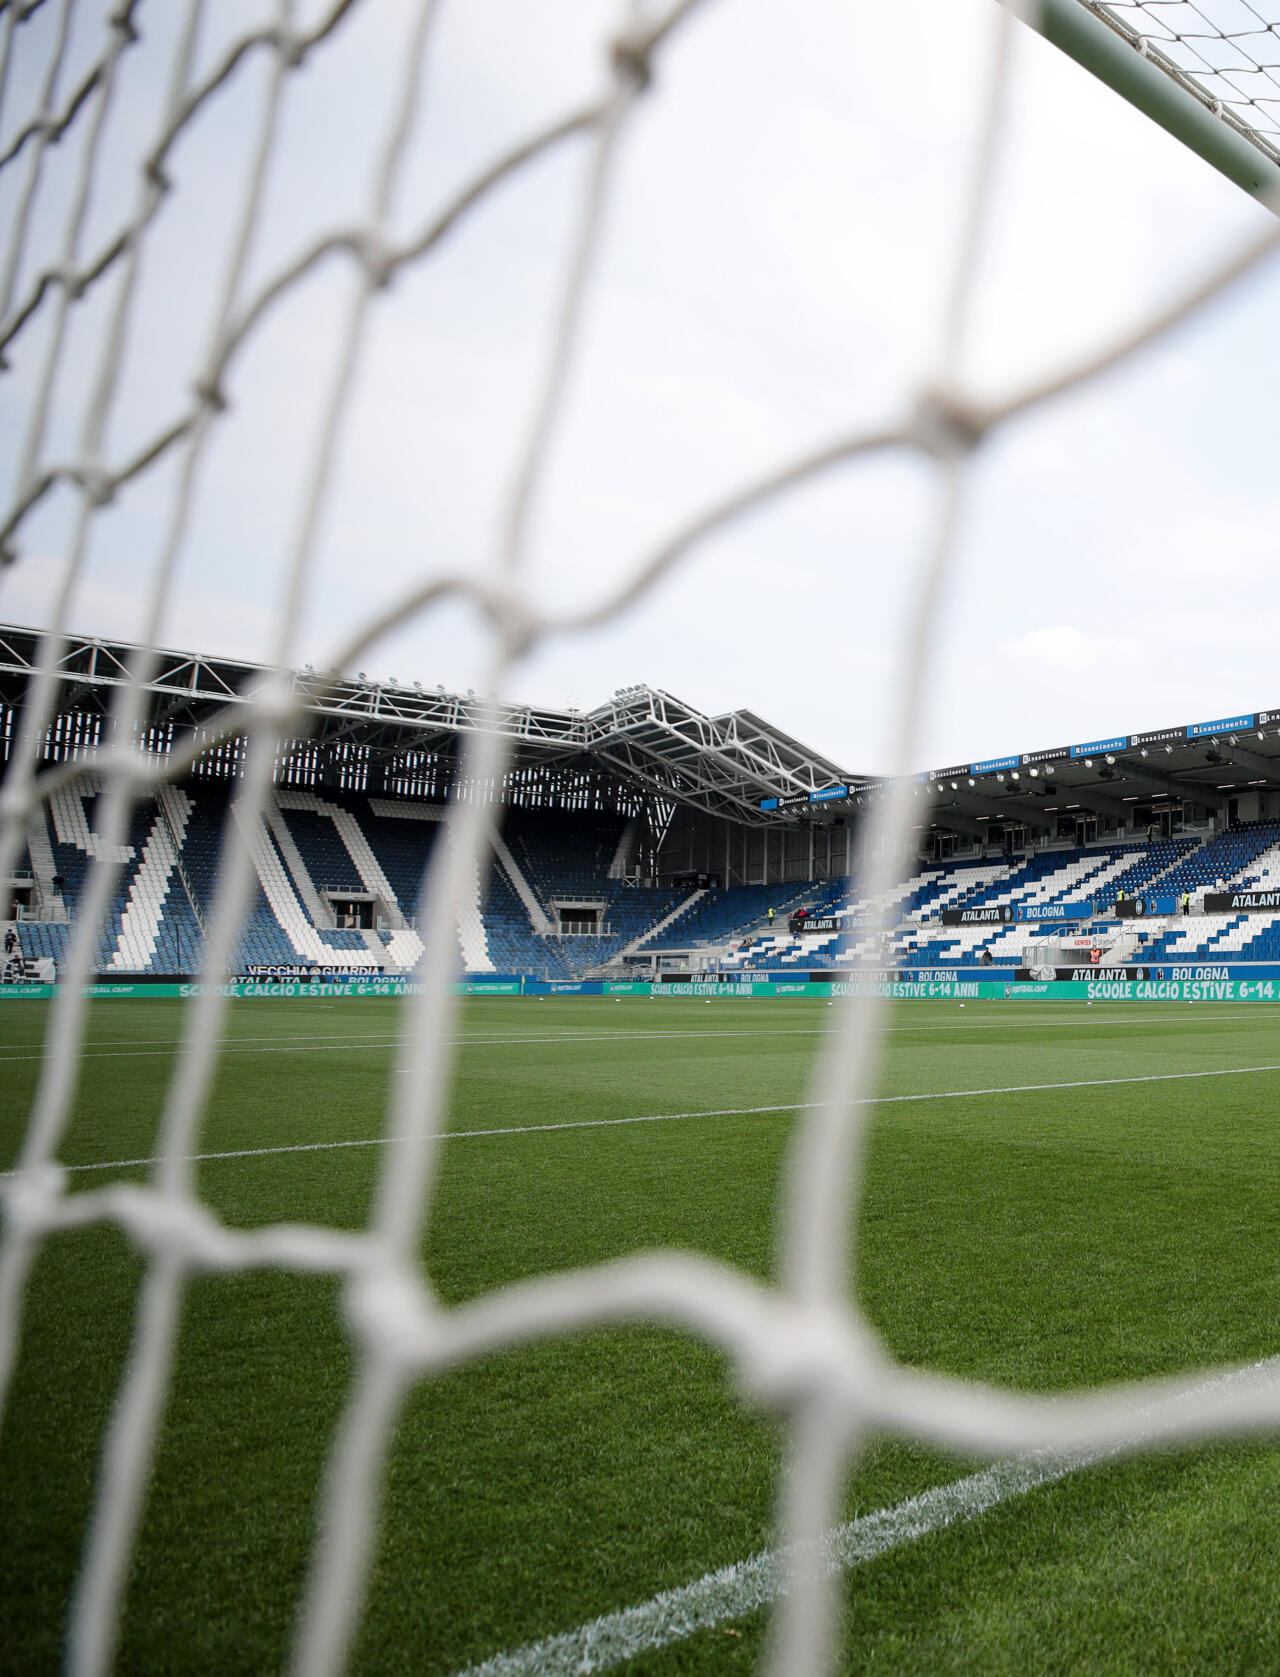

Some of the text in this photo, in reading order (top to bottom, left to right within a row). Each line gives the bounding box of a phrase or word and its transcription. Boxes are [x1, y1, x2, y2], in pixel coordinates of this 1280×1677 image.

[1193, 719, 1248, 735] Rinascimento
[961, 905, 1065, 922] ATALANTA BOLOGNA
[803, 919, 833, 930] ATALANTA
[322, 965, 380, 976] GUARDIA
[918, 971, 958, 982] BOLOGNA
[1072, 967, 1230, 981] ATALANTA BOLOGNA
[357, 983, 390, 995] 6-14
[394, 983, 424, 995] ANN
[928, 983, 951, 997] 6-14
[1087, 982, 1132, 999] SCUOLE
[1239, 982, 1274, 998] 6-14
